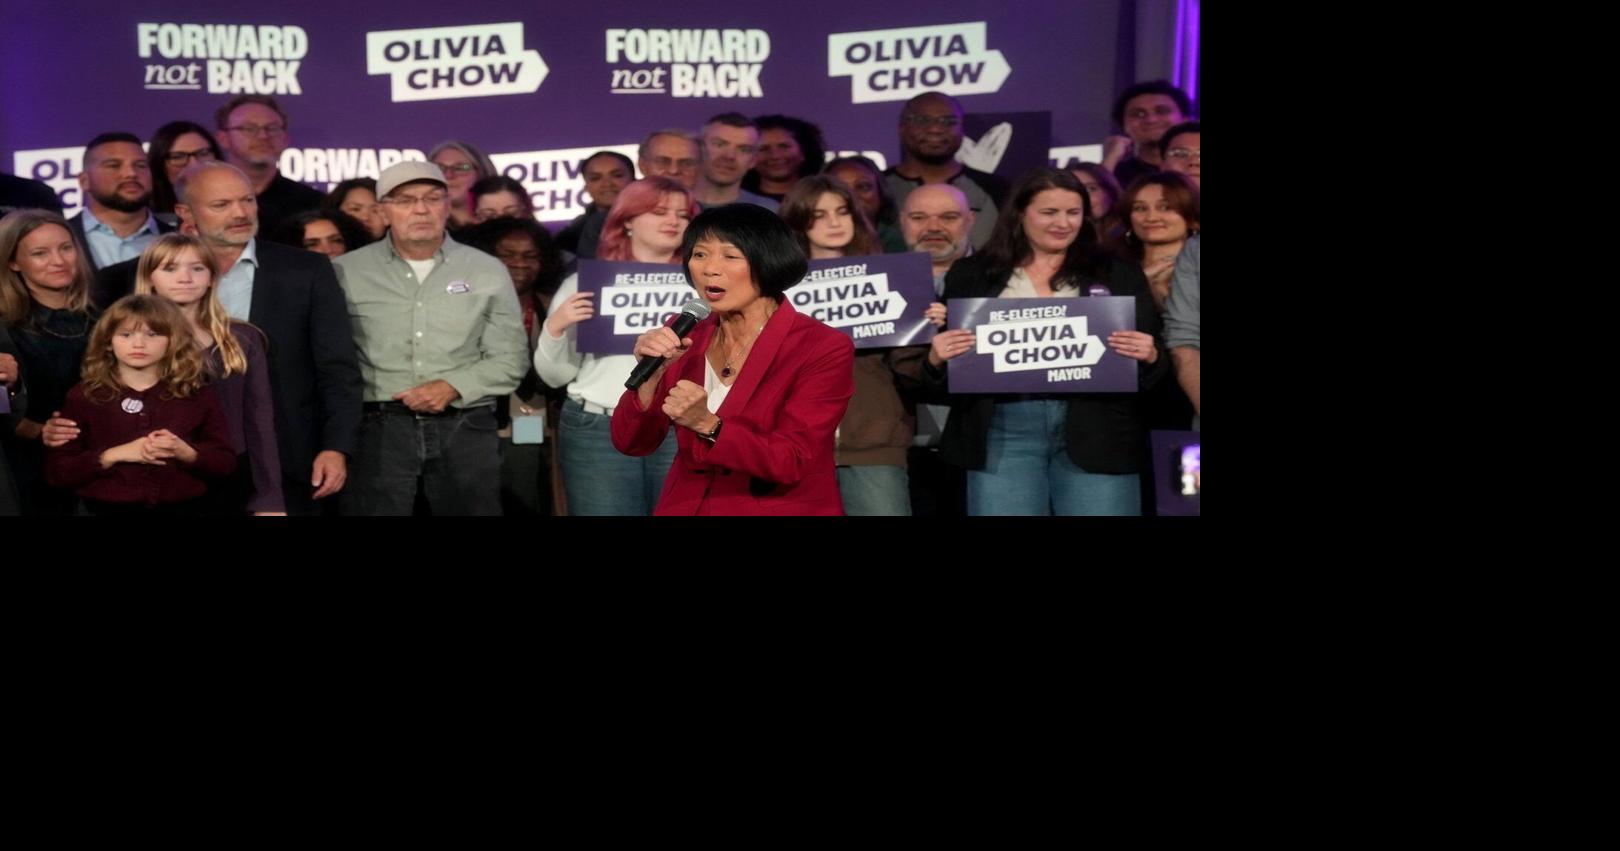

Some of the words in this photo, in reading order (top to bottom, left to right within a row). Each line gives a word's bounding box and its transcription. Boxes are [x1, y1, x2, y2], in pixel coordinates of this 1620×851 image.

[137, 23, 308, 60] FORWARD
[384, 34, 506, 62] OLIVIA
[606, 28, 771, 63] FORWARD
[845, 34, 968, 64] OLIVIA
[144, 63, 201, 84] not
[207, 60, 302, 95] BACK
[408, 62, 523, 90] CHOW
[611, 67, 667, 88] not
[671, 63, 764, 97] BACK
[868, 62, 985, 91] CHOW
[503, 159, 586, 182] OLIV
[530, 188, 592, 211] CHO
[615, 272, 687, 285] RE-ELECTED
[793, 282, 877, 306] OLIVIA
[811, 299, 889, 322] CHOW
[989, 305, 1067, 321] RE-ELECTED!
[853, 322, 895, 339] MAYOR
[988, 324, 1076, 346] OLIVIA
[1004, 343, 1088, 364] CHOW
[1047, 367, 1092, 382] MAYOR
